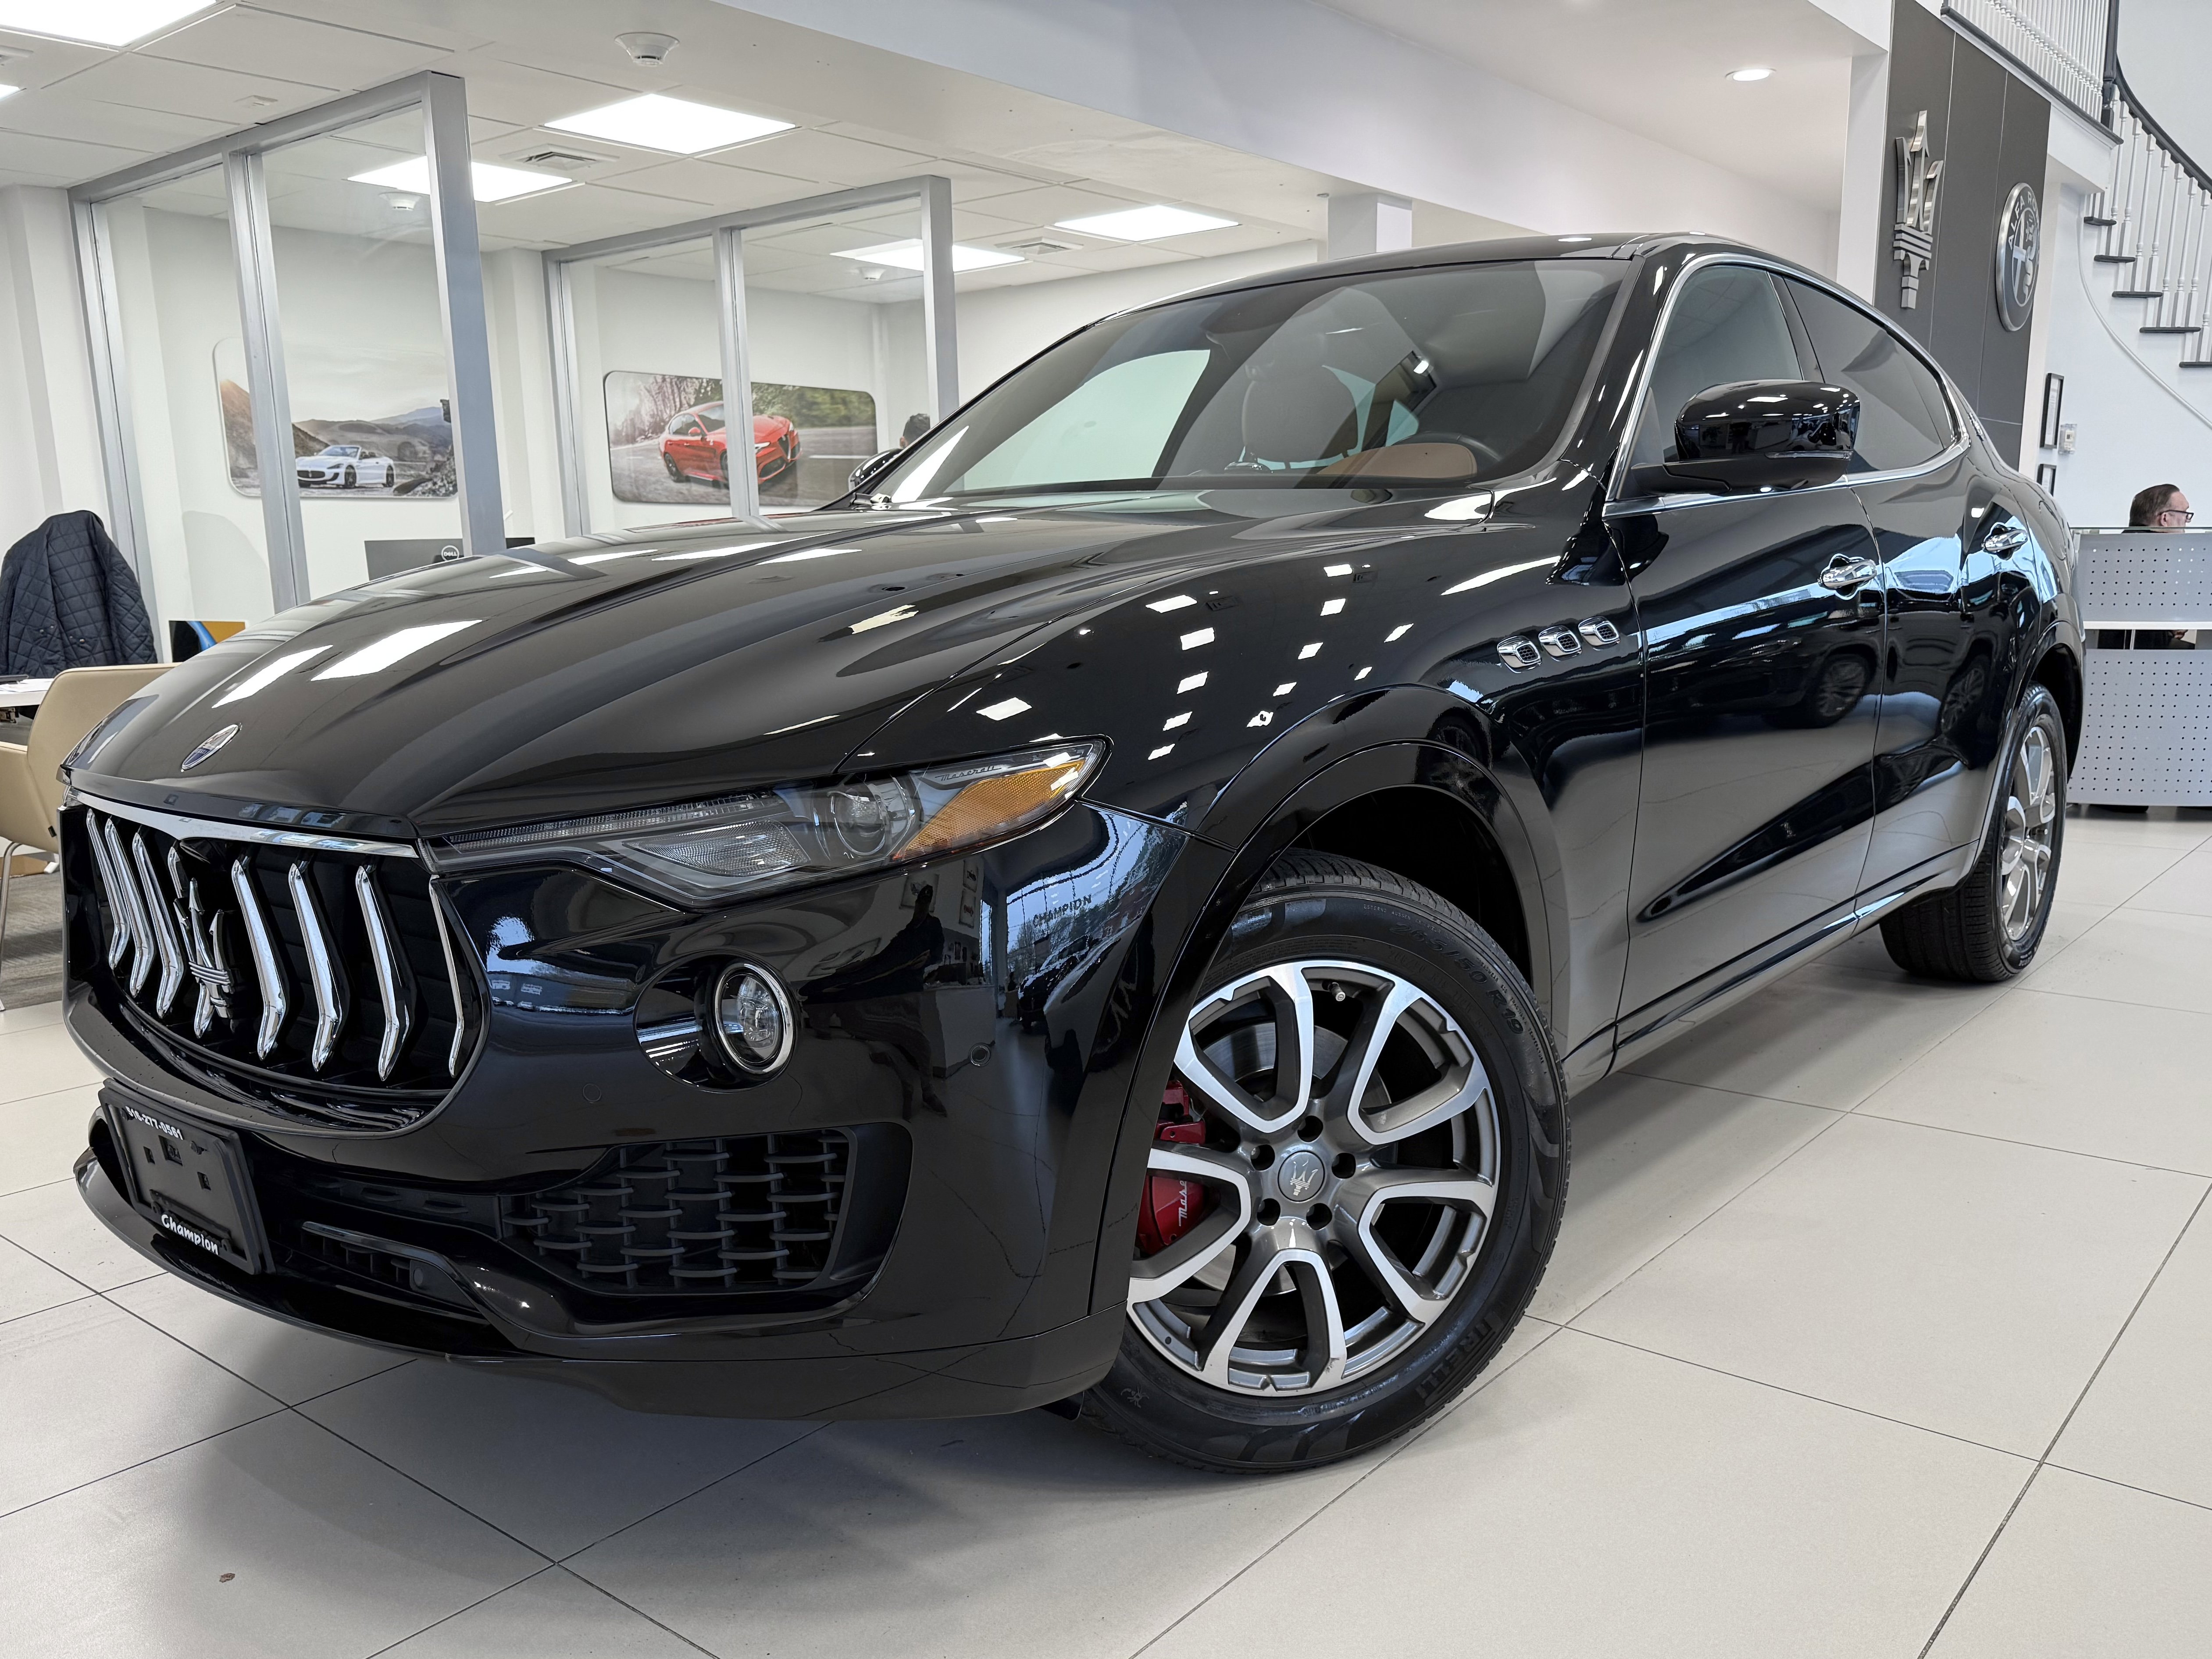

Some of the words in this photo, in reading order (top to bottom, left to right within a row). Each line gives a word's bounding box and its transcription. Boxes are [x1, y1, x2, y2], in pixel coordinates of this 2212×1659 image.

[2008, 196, 2025, 250] ALFA
[935, 766, 1002, 781] Maserati
[1389, 922, 1487, 984] 265/50
